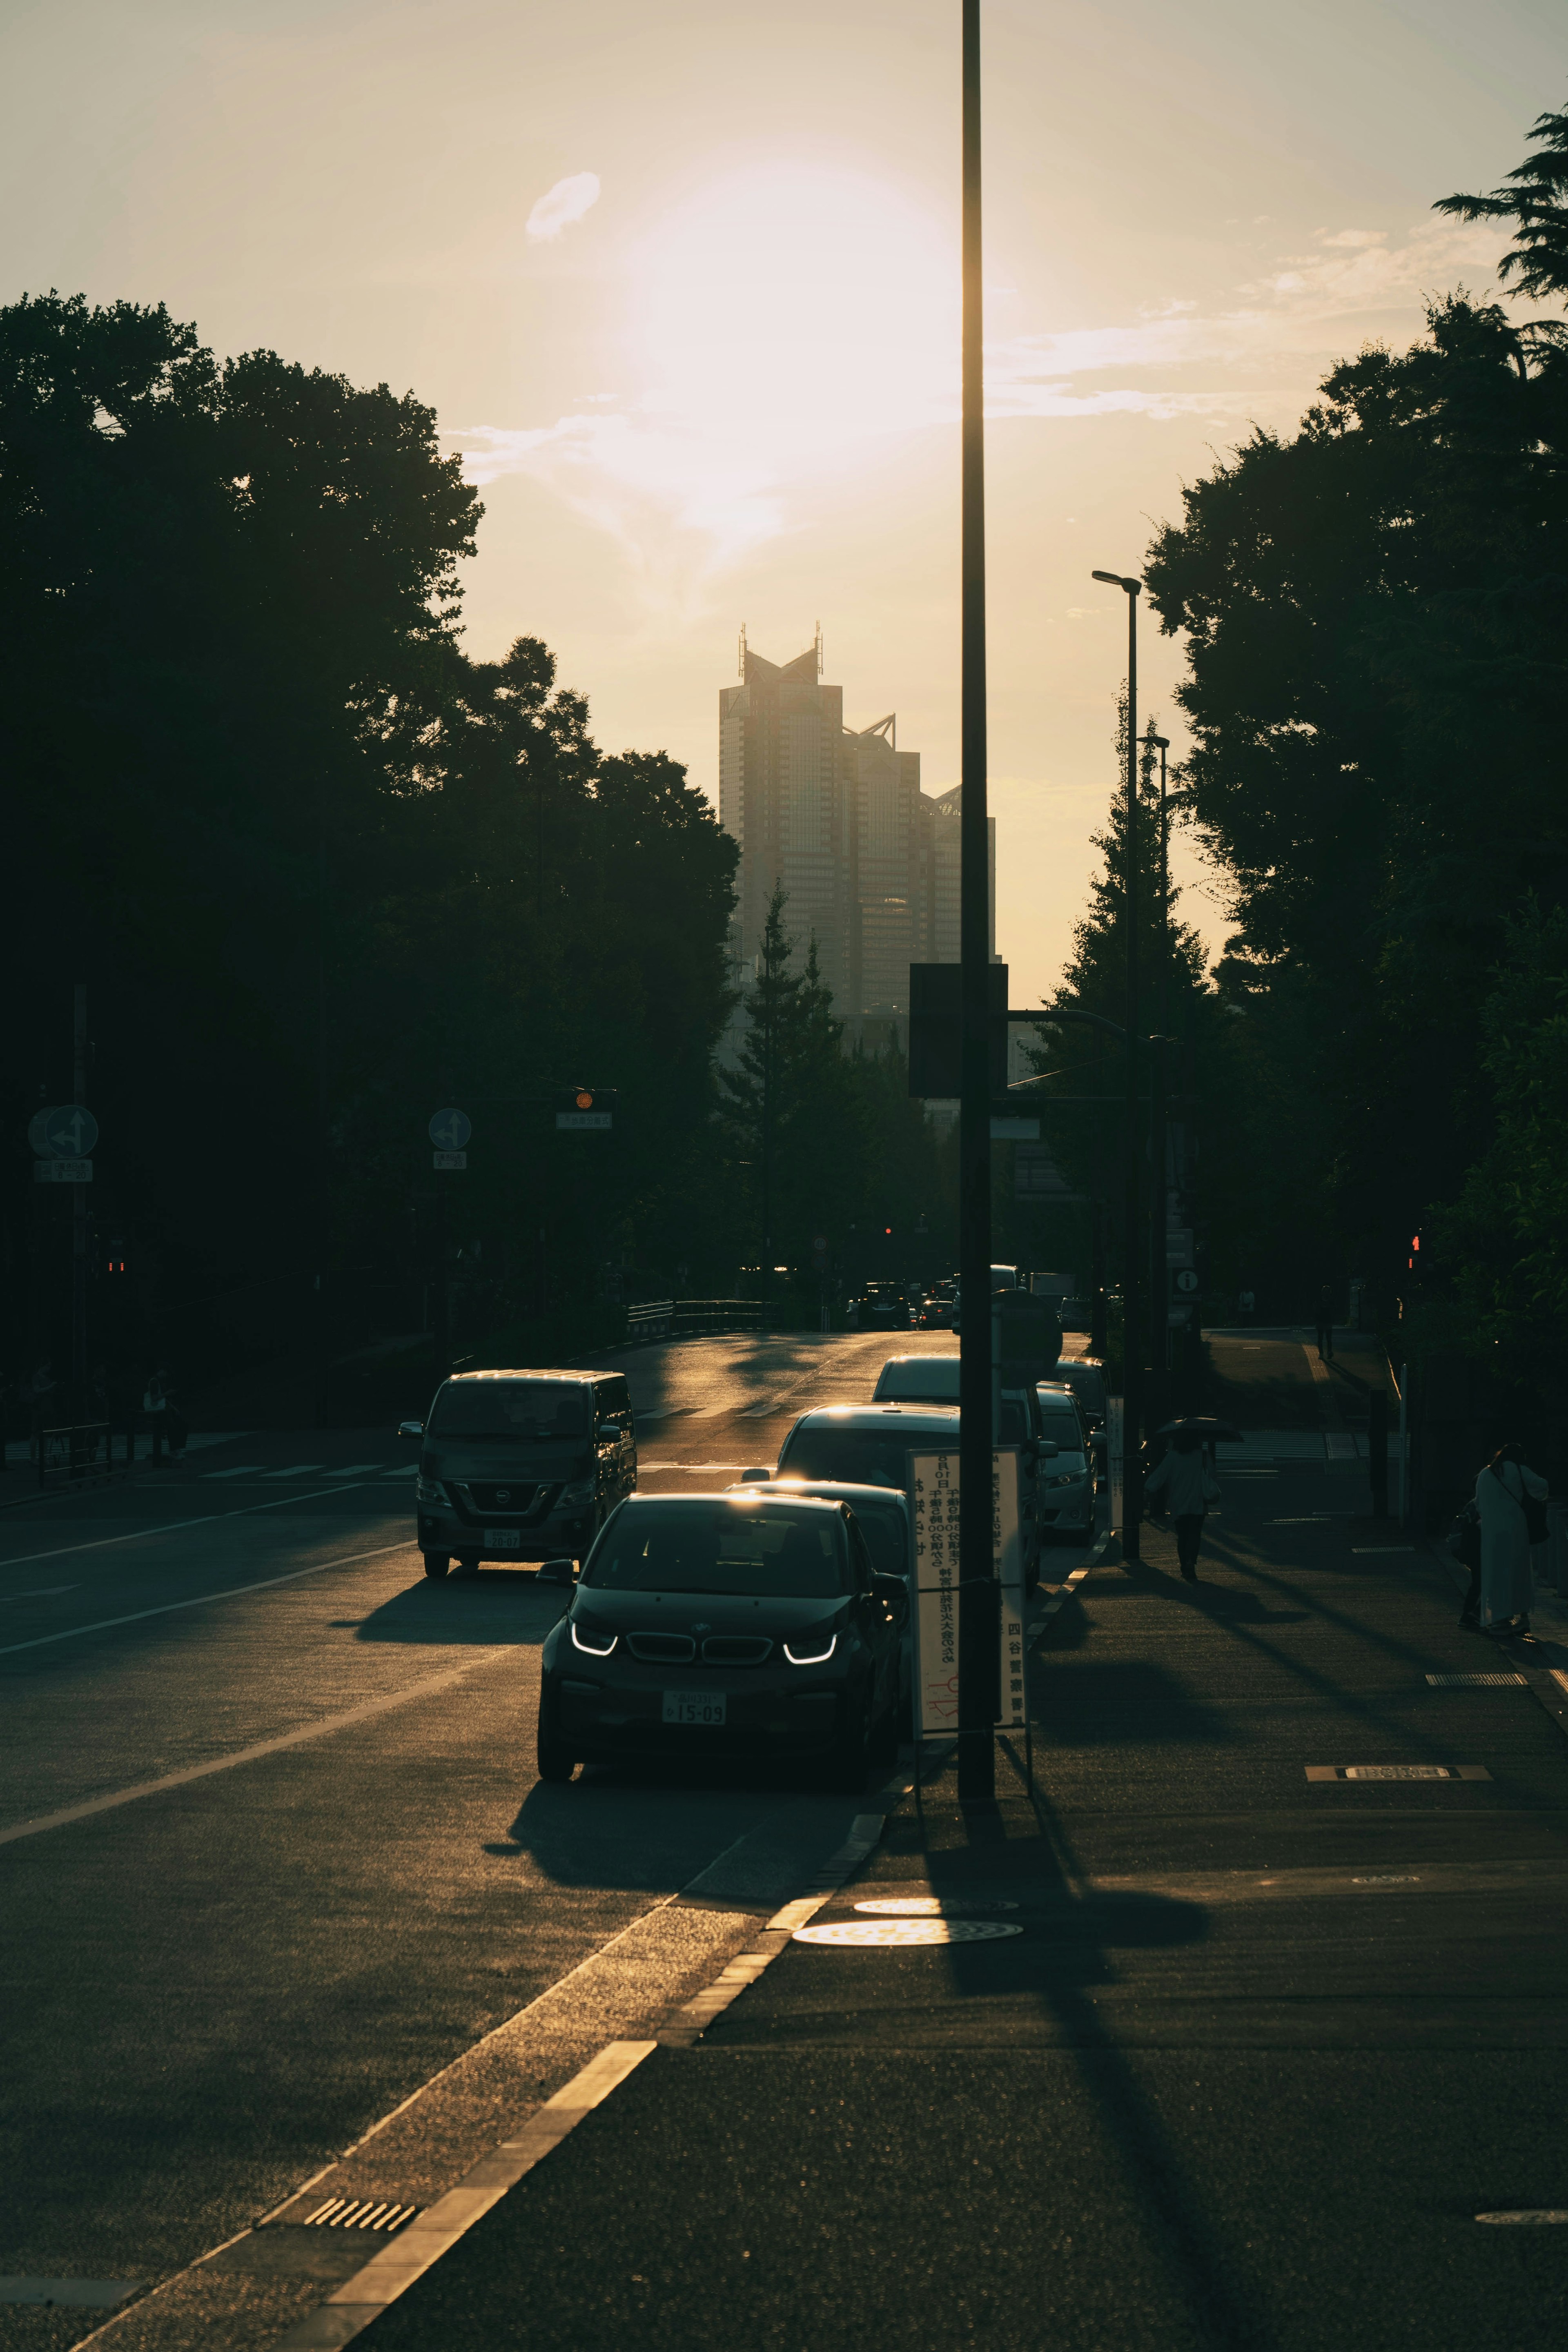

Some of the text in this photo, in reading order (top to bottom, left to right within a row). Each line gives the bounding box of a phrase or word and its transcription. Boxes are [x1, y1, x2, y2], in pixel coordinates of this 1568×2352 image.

[571, 1116, 608, 1125] 歩車分離式
[816, 1240, 825, 1248] 40
[492, 1537, 518, 1547] 20-07
[679, 1704, 722, 1722] 15-09
